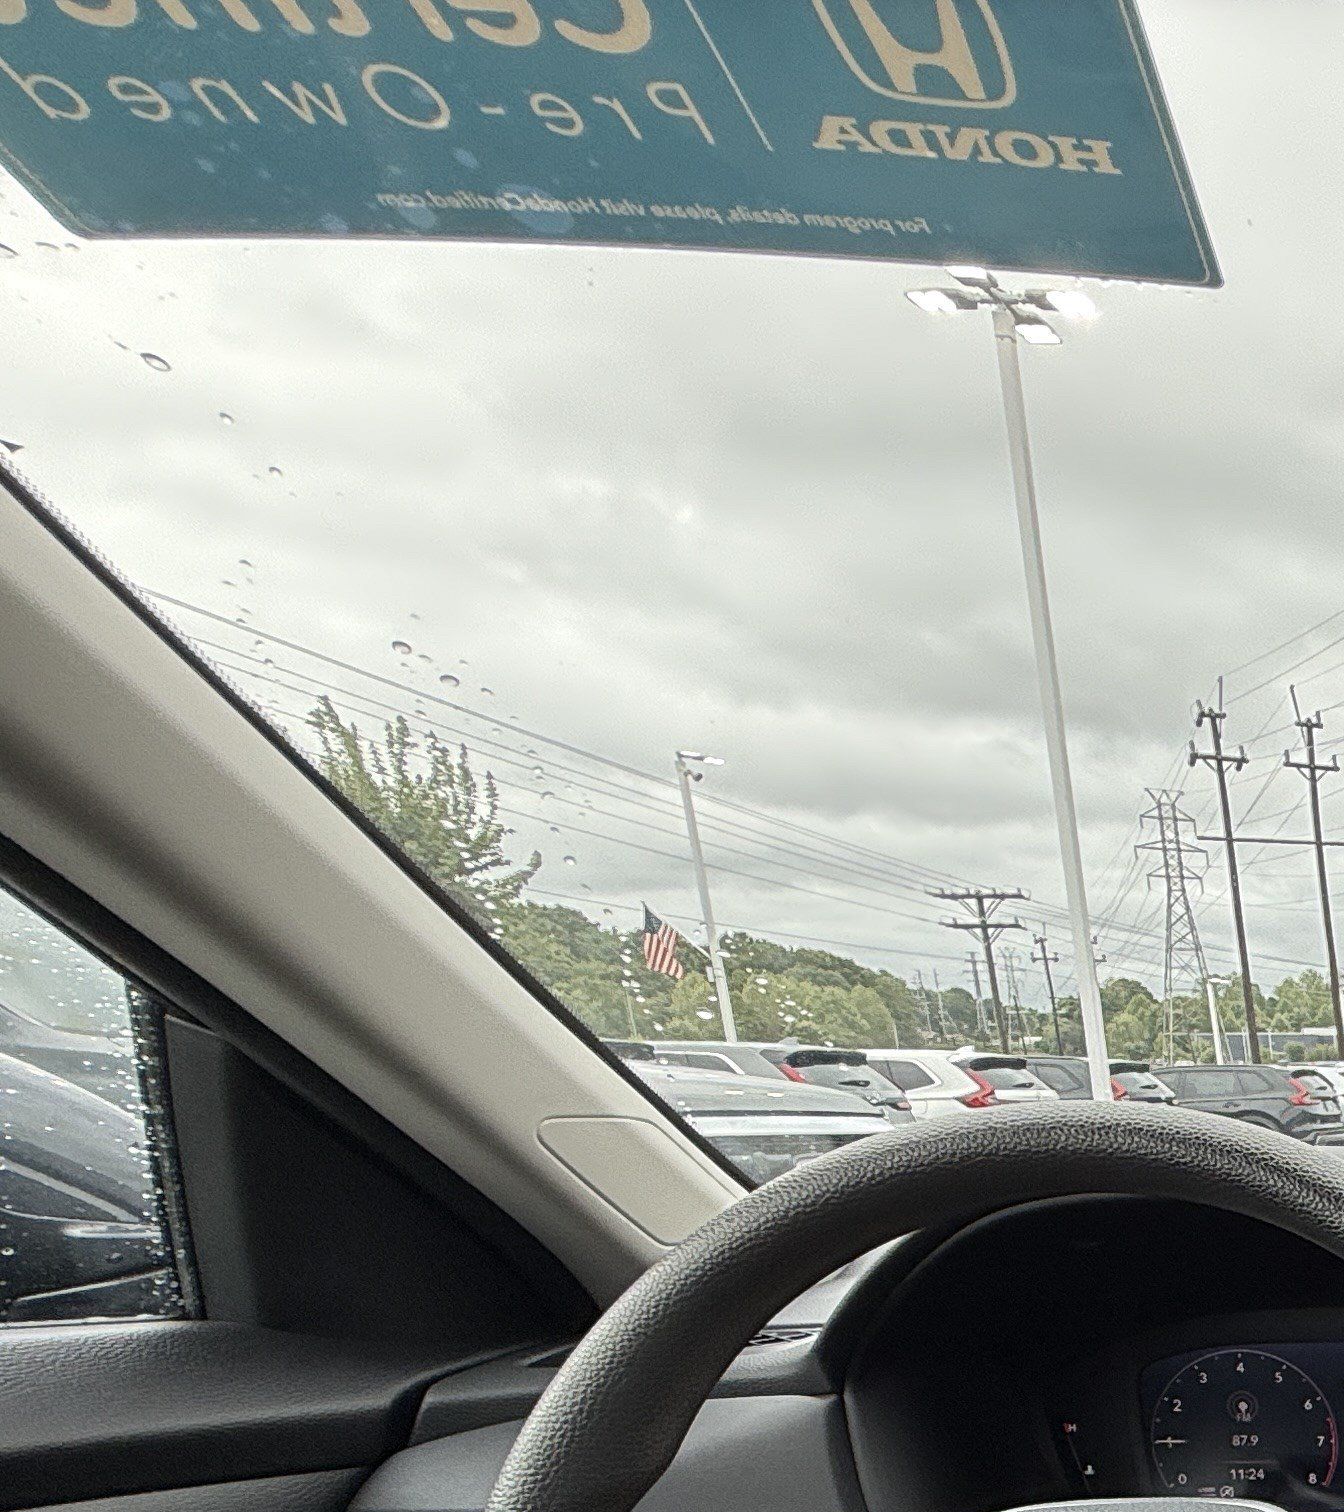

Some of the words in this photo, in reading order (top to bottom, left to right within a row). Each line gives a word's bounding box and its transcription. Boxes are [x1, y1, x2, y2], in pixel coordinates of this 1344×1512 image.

[1236, 1362, 1245, 1373] 4
[1199, 1372, 1208, 1384] 3
[1274, 1372, 1283, 1383] 5
[1173, 1400, 1182, 1412] 2
[1304, 1399, 1313, 1410] 6
[1231, 1435, 1259, 1446] 87.9
[1316, 1435, 1325, 1447] 7
[1178, 1473, 1188, 1485] 0
[1229, 1468, 1265, 1480] 11:24
[1308, 1473, 1318, 1485] 8
